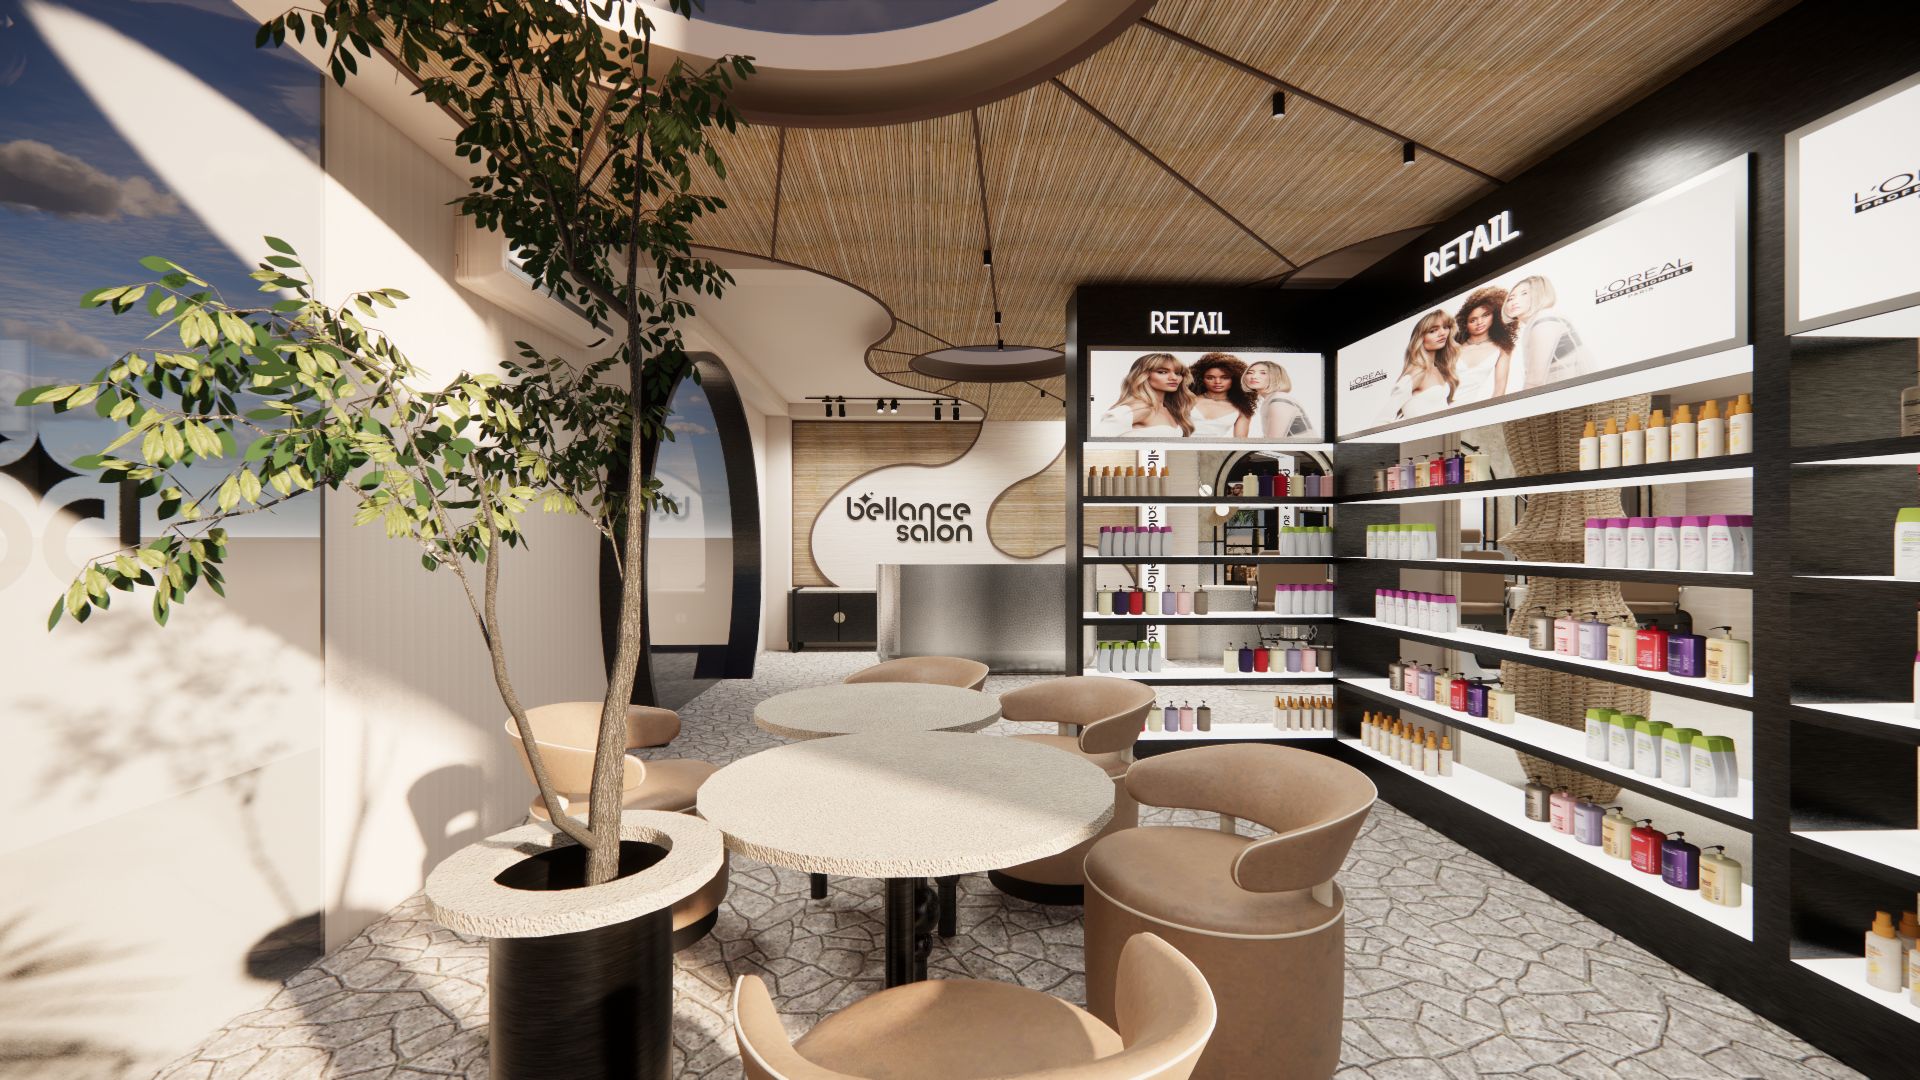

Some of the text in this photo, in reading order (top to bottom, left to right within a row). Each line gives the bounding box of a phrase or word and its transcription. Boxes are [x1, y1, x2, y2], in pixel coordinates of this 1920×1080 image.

[1855, 170, 1920, 203] L'O
[1424, 210, 1520, 283] RETAIL
[1597, 266, 1691, 303] PROFESSIONNEL
[1150, 310, 1231, 335] RETAIL
[846, 495, 971, 521] bellance
[896, 523, 973, 542] salon
